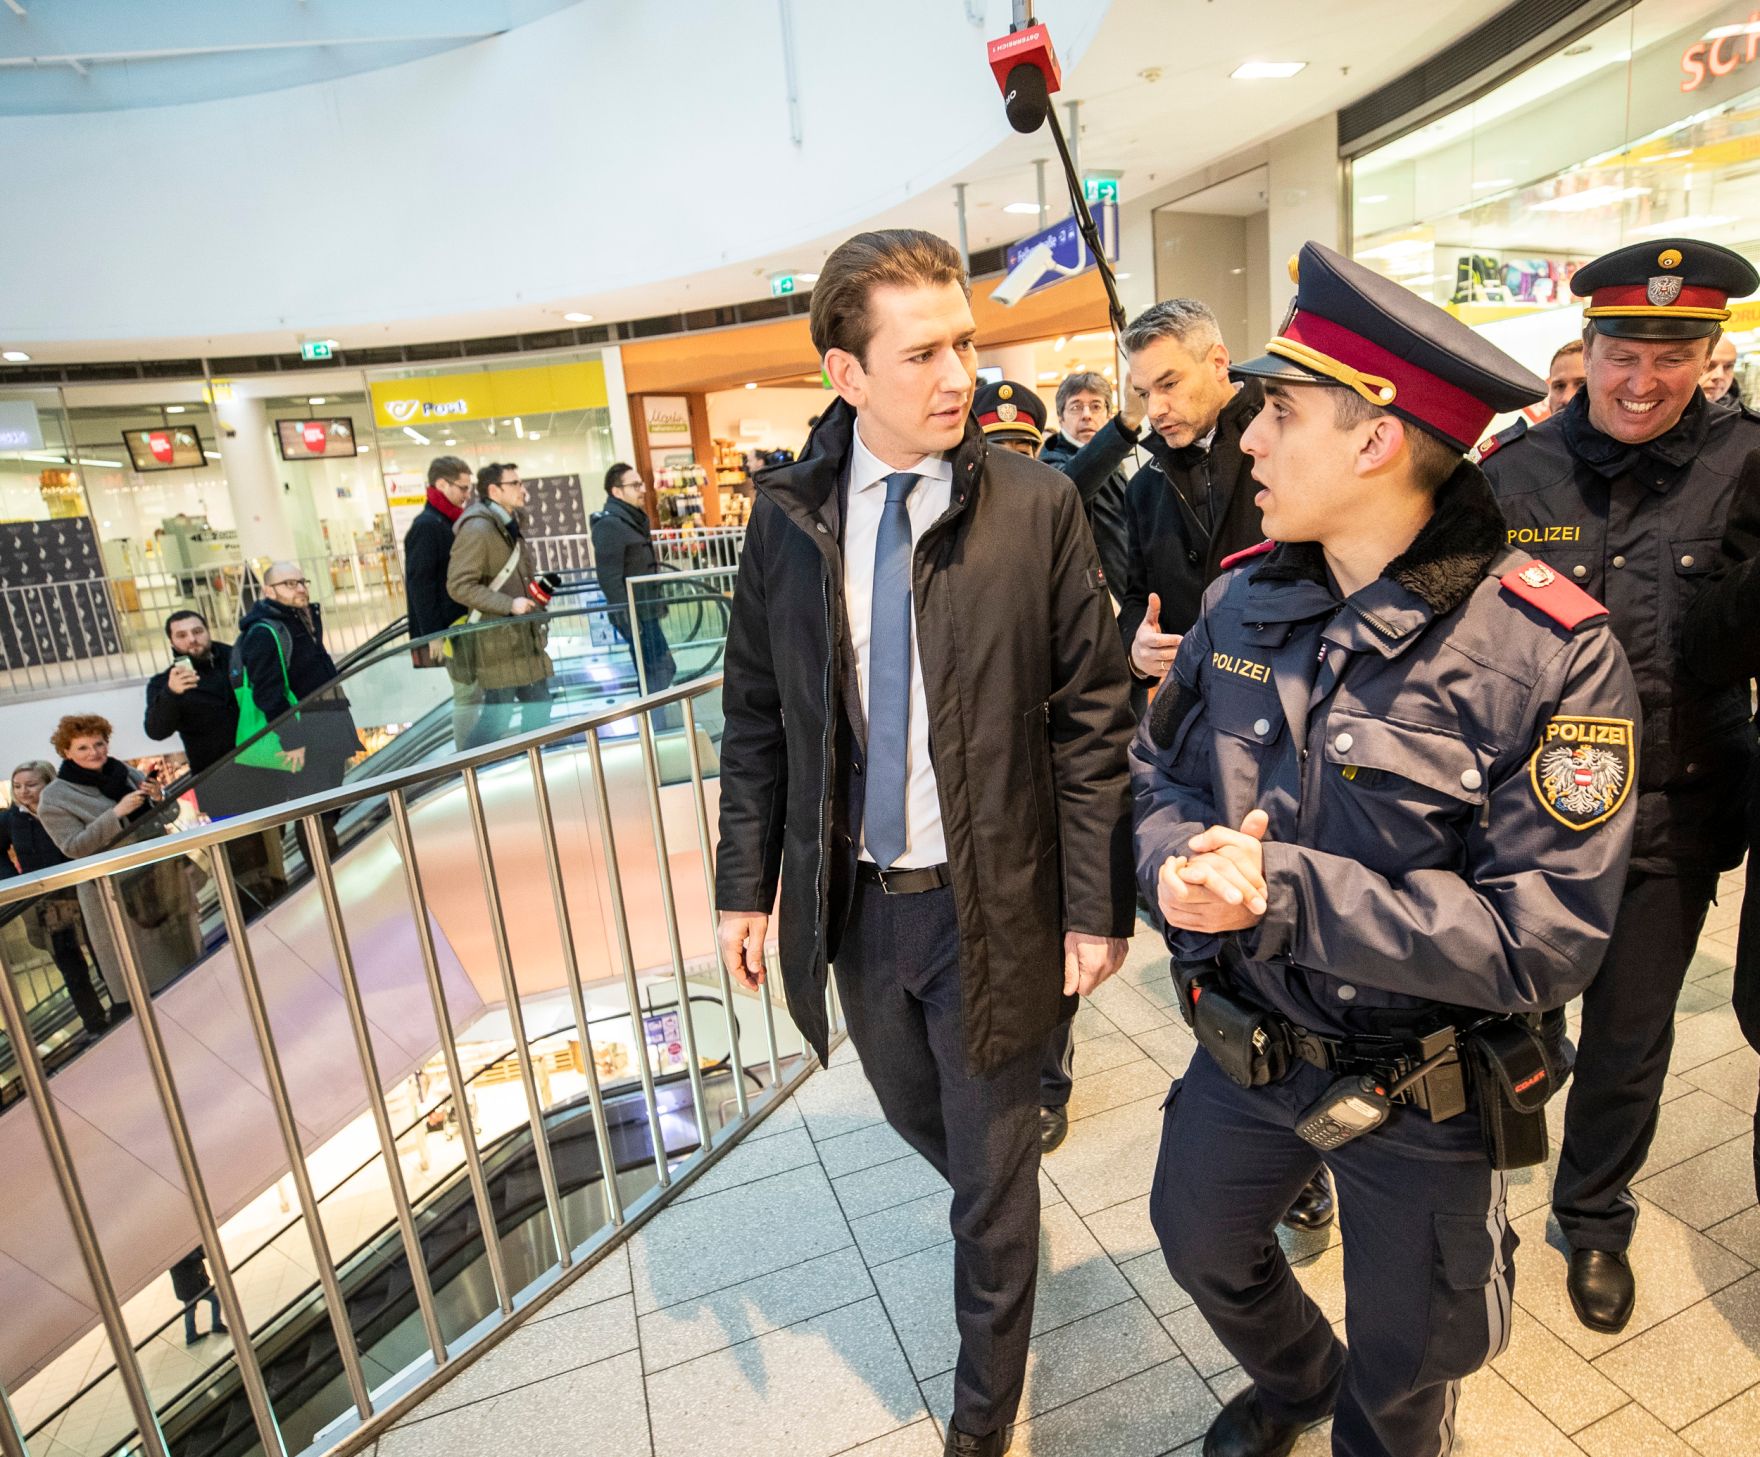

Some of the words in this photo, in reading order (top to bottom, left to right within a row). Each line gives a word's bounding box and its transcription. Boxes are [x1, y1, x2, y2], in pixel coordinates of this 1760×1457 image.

[423, 399, 467, 417] Post
[1507, 526, 1580, 544] POLIZEI
[1212, 652, 1271, 684] POLIZEI
[1546, 723, 1626, 745] POLIZEI
